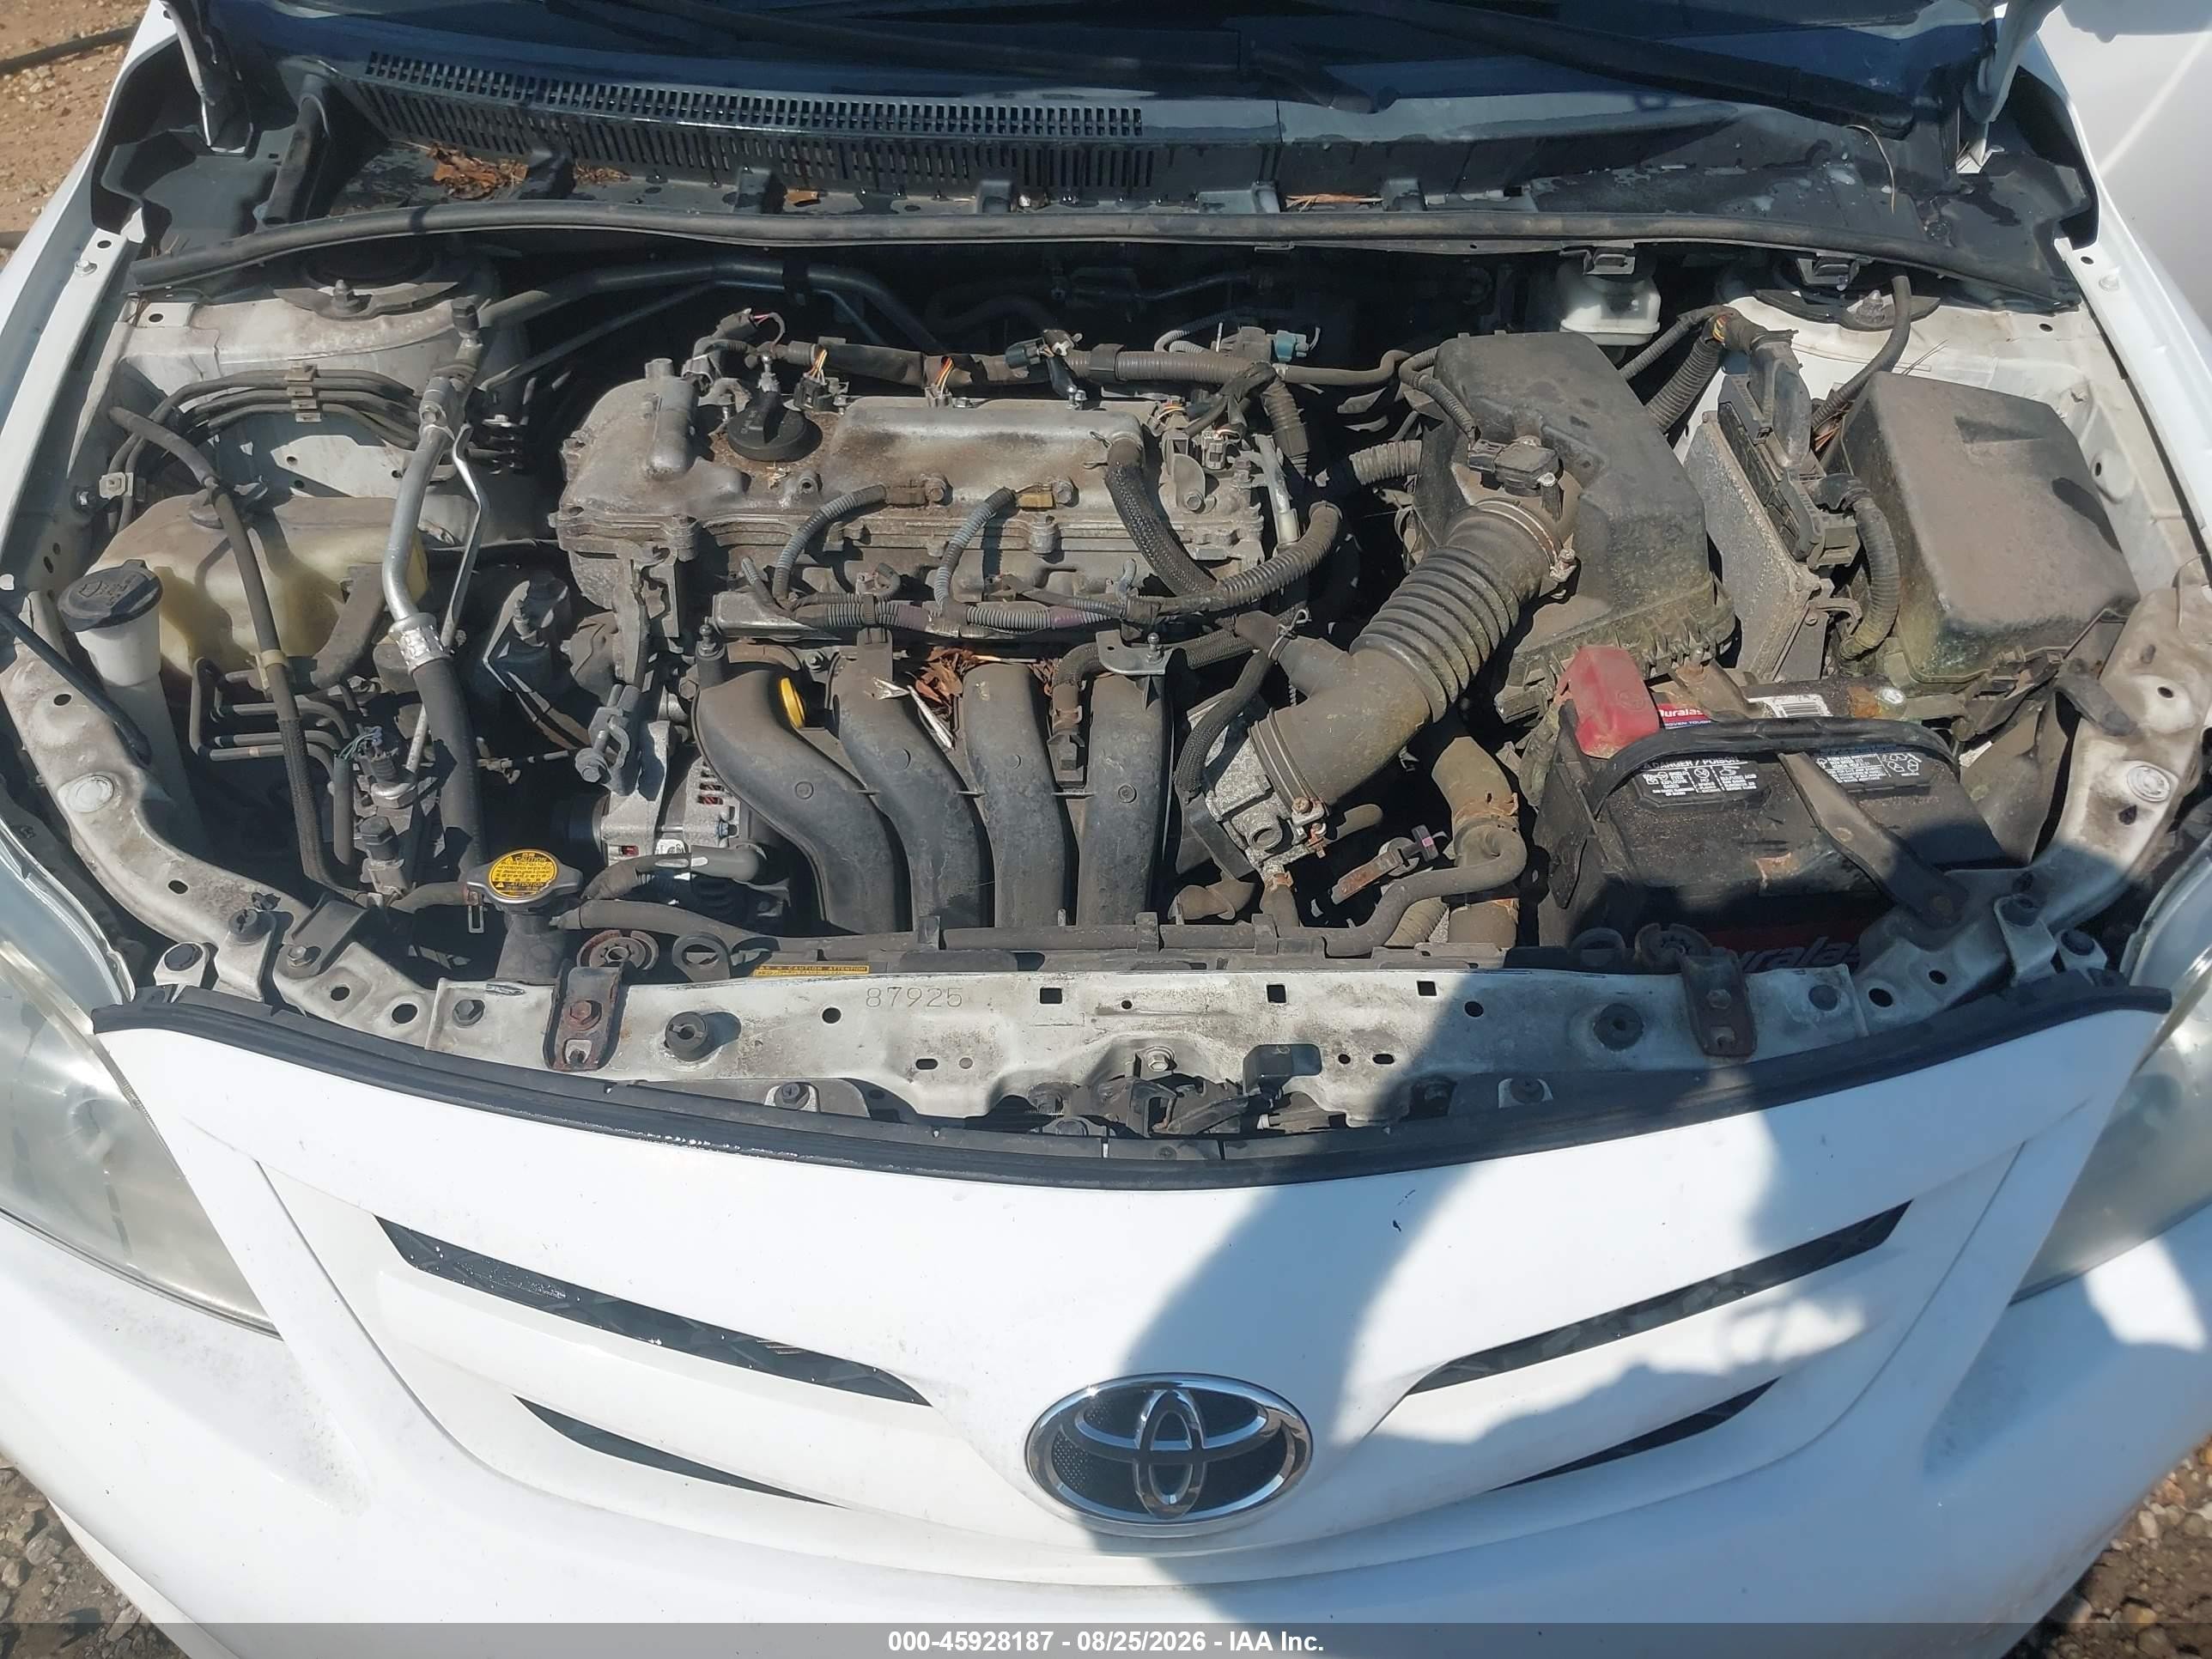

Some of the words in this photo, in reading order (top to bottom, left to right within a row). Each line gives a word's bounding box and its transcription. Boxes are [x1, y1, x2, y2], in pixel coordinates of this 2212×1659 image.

[1652, 760, 1693, 769] DANGER
[1703, 756, 1740, 765] POISON
[866, 986, 963, 1008] 87925
